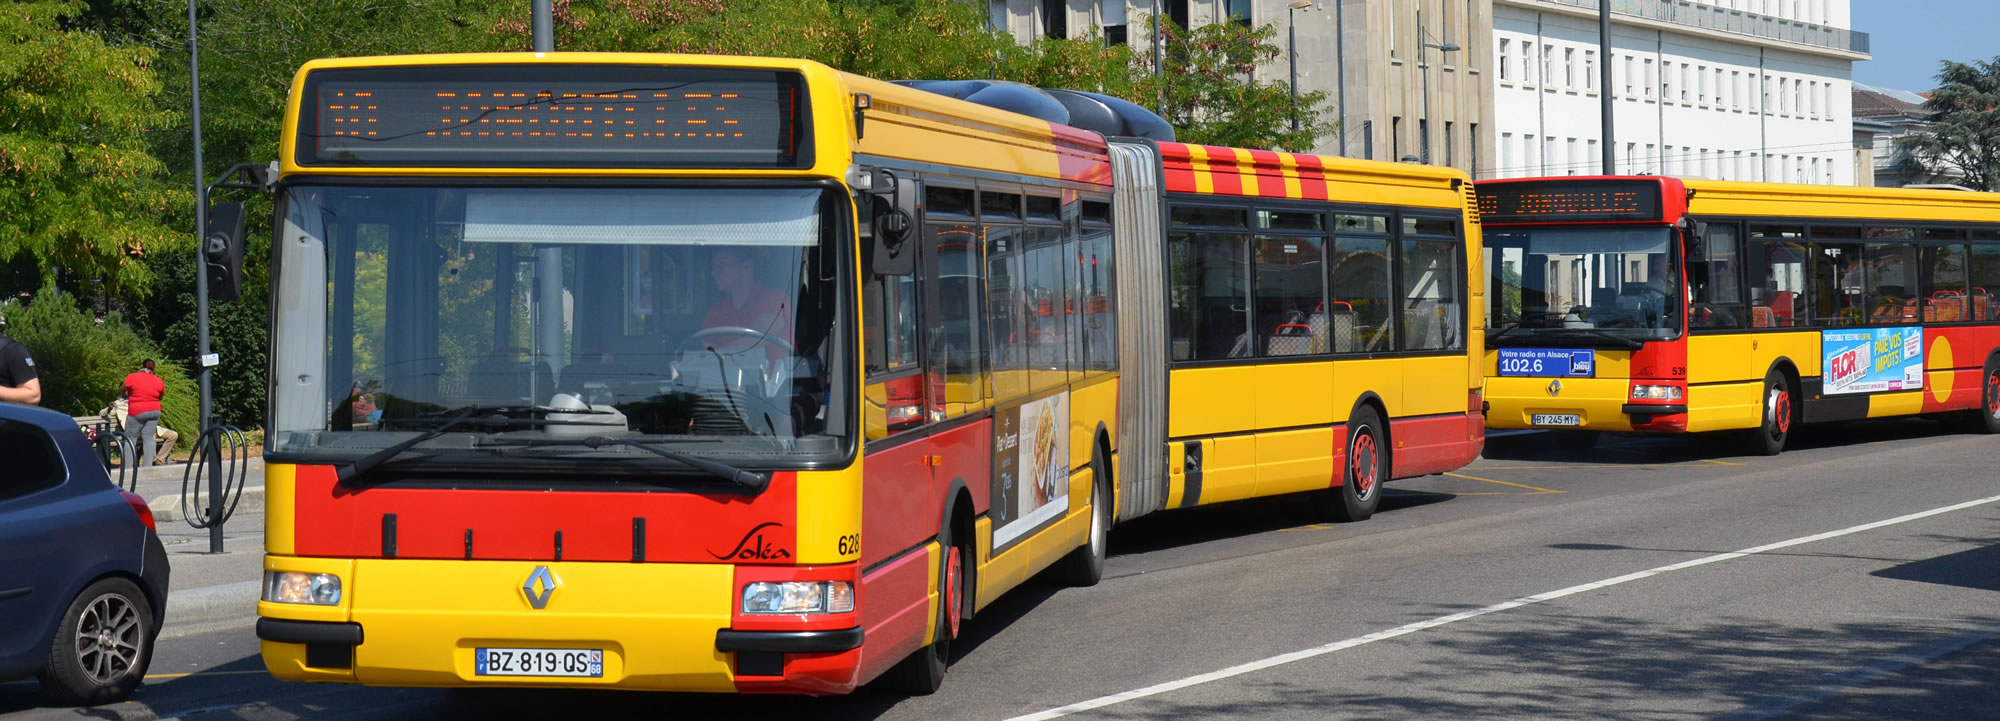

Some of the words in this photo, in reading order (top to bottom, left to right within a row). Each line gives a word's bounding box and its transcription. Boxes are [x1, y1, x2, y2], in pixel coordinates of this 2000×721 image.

[1874, 337, 1889, 357] PAIE
[1889, 332, 1902, 349] VOS
[1519, 350, 1536, 358] radio
[1501, 358, 1543, 372] 102.6
[1573, 361, 1590, 370] bleu
[1831, 350, 1856, 382] FLOR
[706, 522, 791, 561] Soléa
[838, 533, 860, 556] 628
[591, 664, 601, 674] 68
